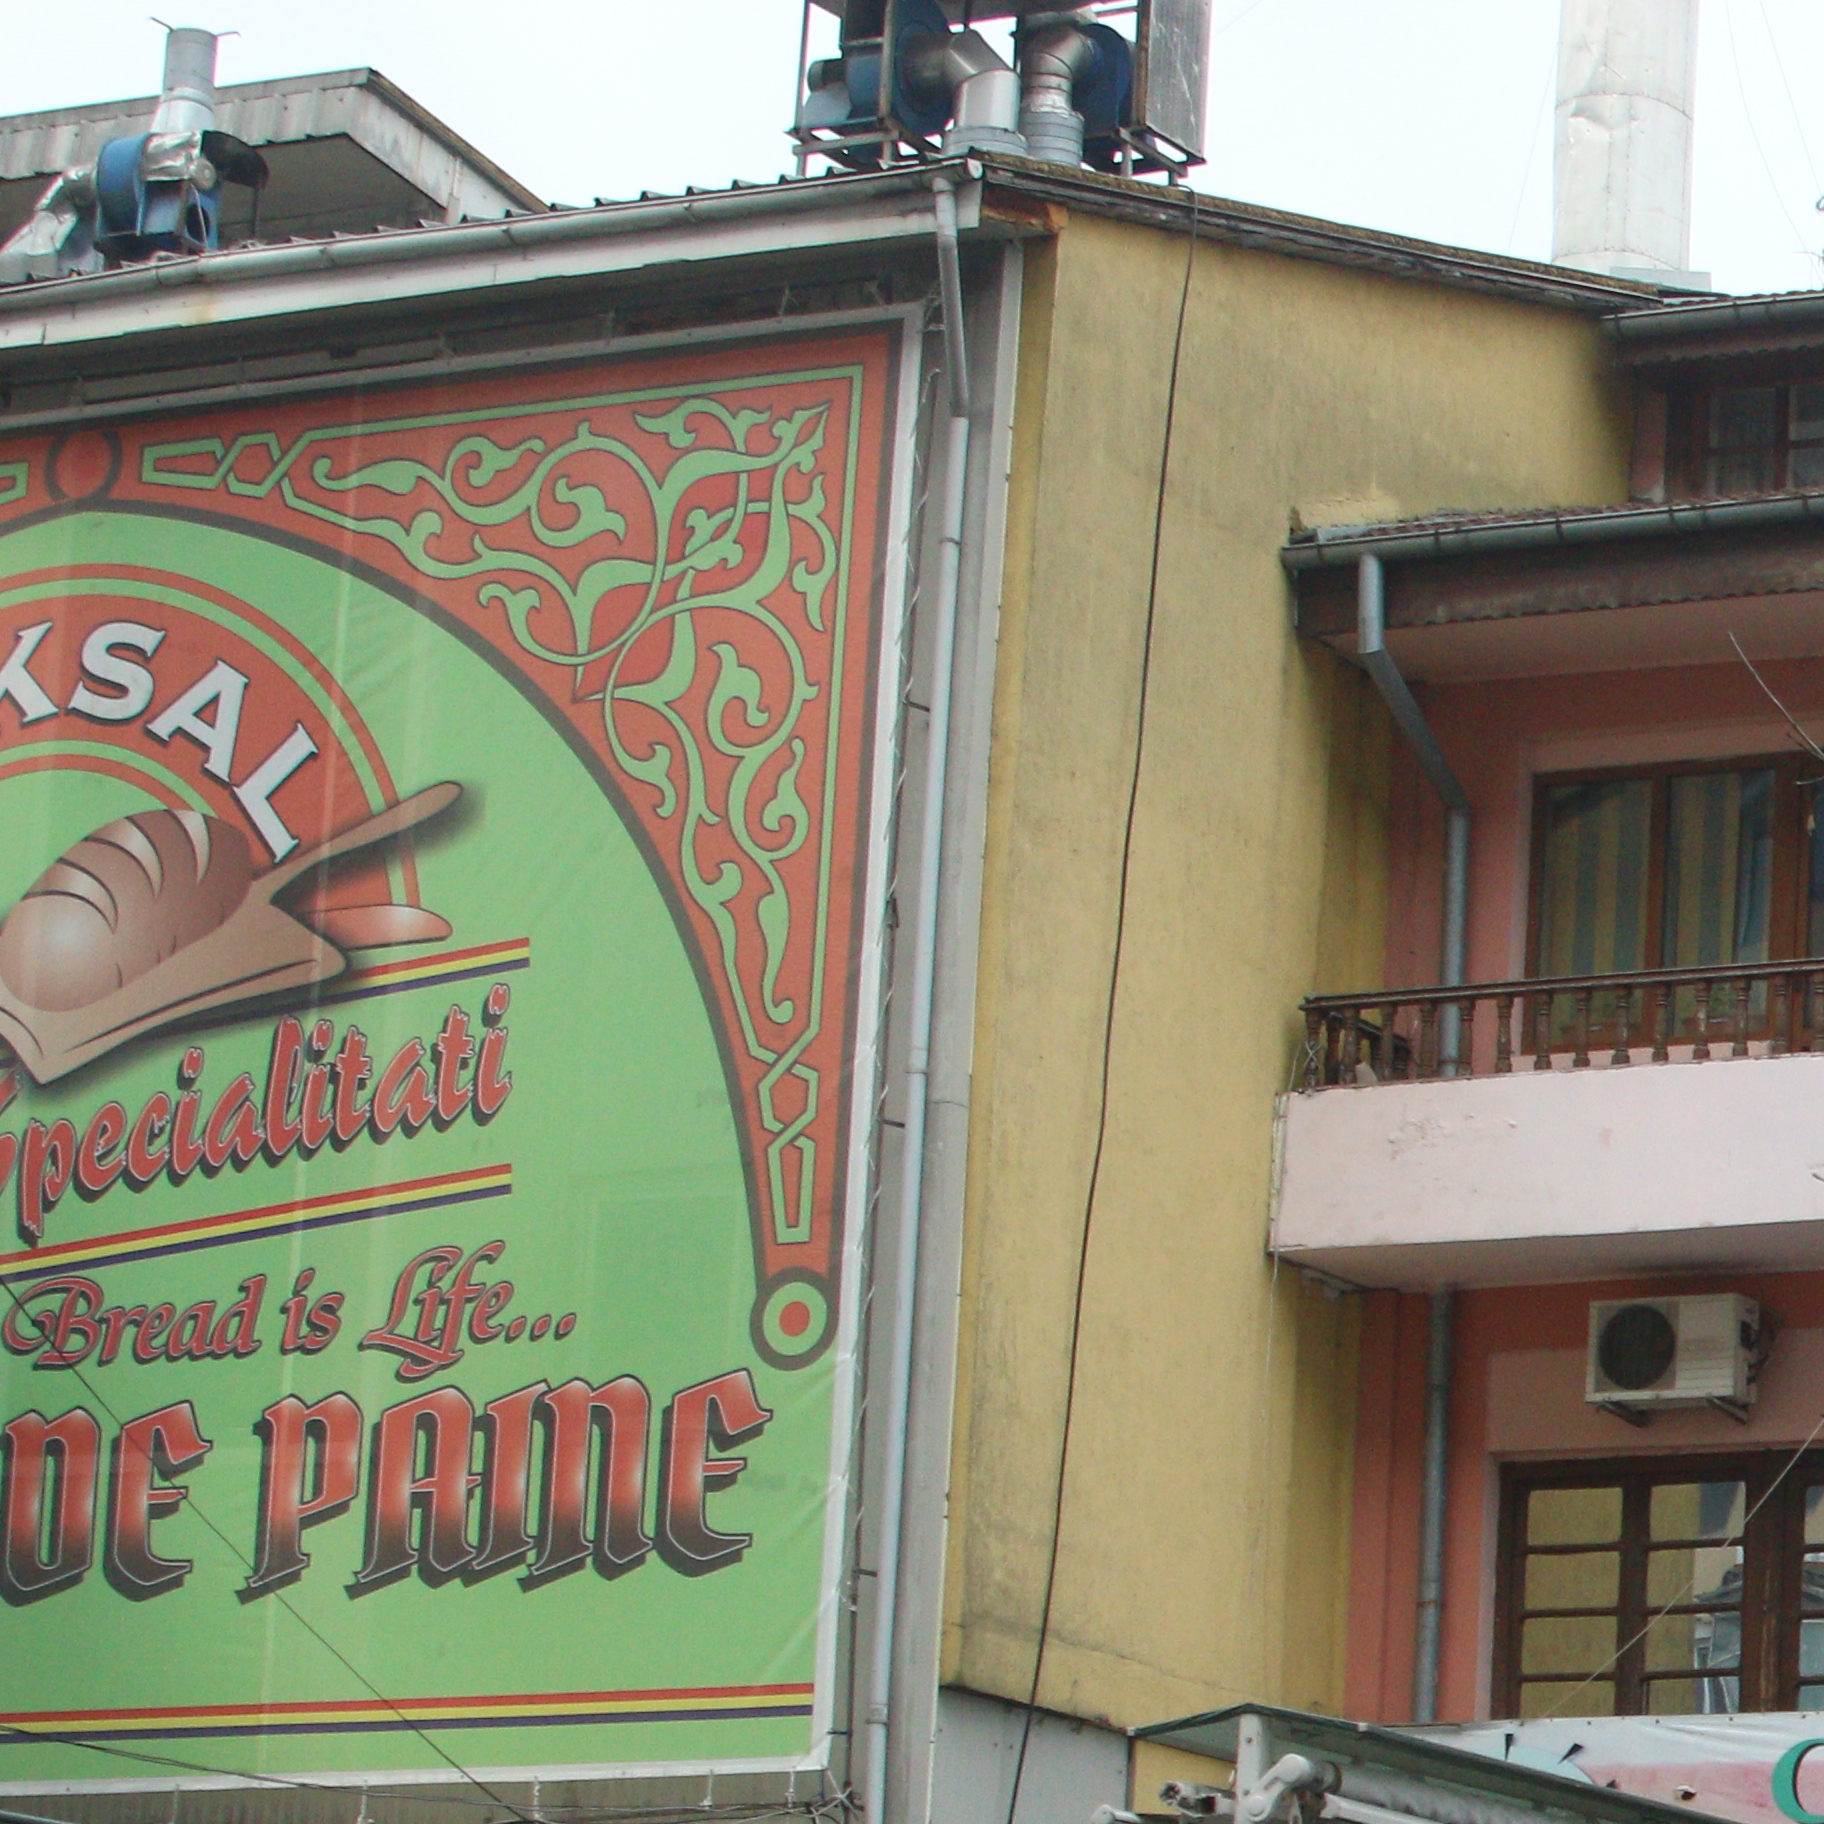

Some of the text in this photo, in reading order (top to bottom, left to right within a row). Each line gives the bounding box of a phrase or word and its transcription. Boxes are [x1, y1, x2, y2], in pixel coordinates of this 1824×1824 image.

[3, 1240, 578, 1382] Bread is Life...
